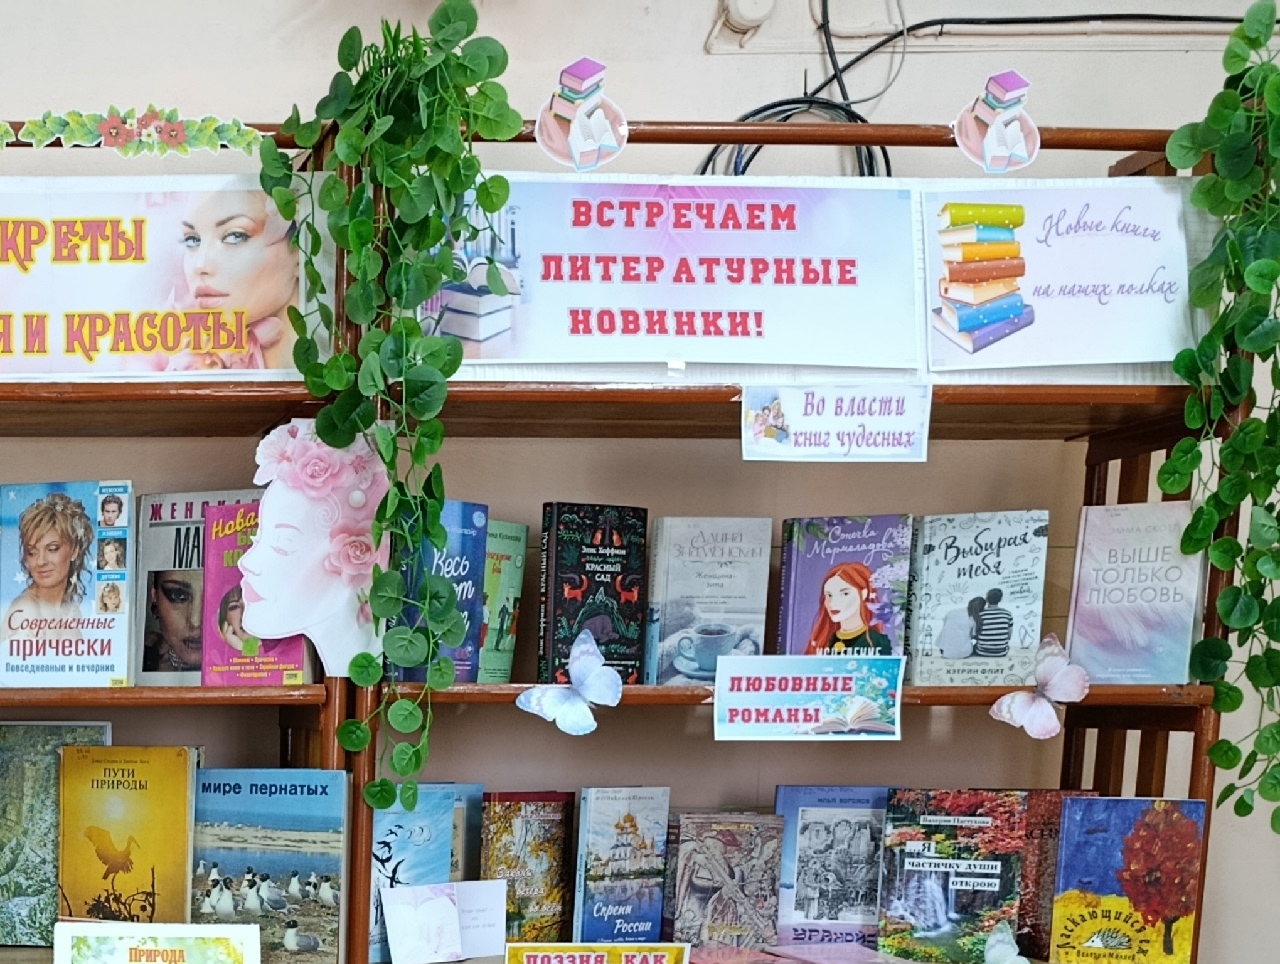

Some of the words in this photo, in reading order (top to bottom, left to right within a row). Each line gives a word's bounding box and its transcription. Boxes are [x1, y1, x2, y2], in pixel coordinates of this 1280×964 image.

[570, 199, 798, 232] ВСТРЕЧАЕМ
[1036, 211, 1106, 248] Новые
[1104, 205, 1161, 243] книги
[539, 253, 859, 286] ЛИТЕРАТУРНЫЕ
[1032, 281, 1055, 298] на
[1057, 279, 1112, 306] наших
[1116, 265, 1180, 304] полках
[568, 308, 764, 338] НОВИНКИ!
[22, 312, 48, 354] И
[64, 311, 248, 362] КРАСОТЫ
[802, 391, 826, 417] Во
[833, 394, 907, 418] власти
[792, 429, 831, 449] книг
[835, 423, 916, 458] чудесных
[827, 527, 878, 545] Сонечка
[938, 529, 1033, 563] Выбирая
[1106, 545, 1172, 566] ВЫШЕ
[585, 563, 622, 573] КРАСНЫЙ
[956, 558, 1006, 580] тебя
[1092, 565, 1183, 585] ТОЛЬКО
[1083, 585, 1185, 606] ЛЮБОВЬ
[7, 608, 116, 636] Современные
[8, 636, 113, 661] прически
[5, 661, 65, 675] Повседневные
[76, 662, 116, 674] вечерние
[729, 675, 853, 693] ЛЮБОВНЫЕ
[728, 707, 821, 725] РОМАНЫ
[102, 767, 136, 780] ПУТИ
[91, 779, 149, 791] ПРИРОДЫ
[201, 779, 242, 796] мире
[248, 780, 330, 797] пернатых
[907, 860, 962, 873] частичку
[963, 861, 999, 873] души
[950, 879, 998, 891] открою
